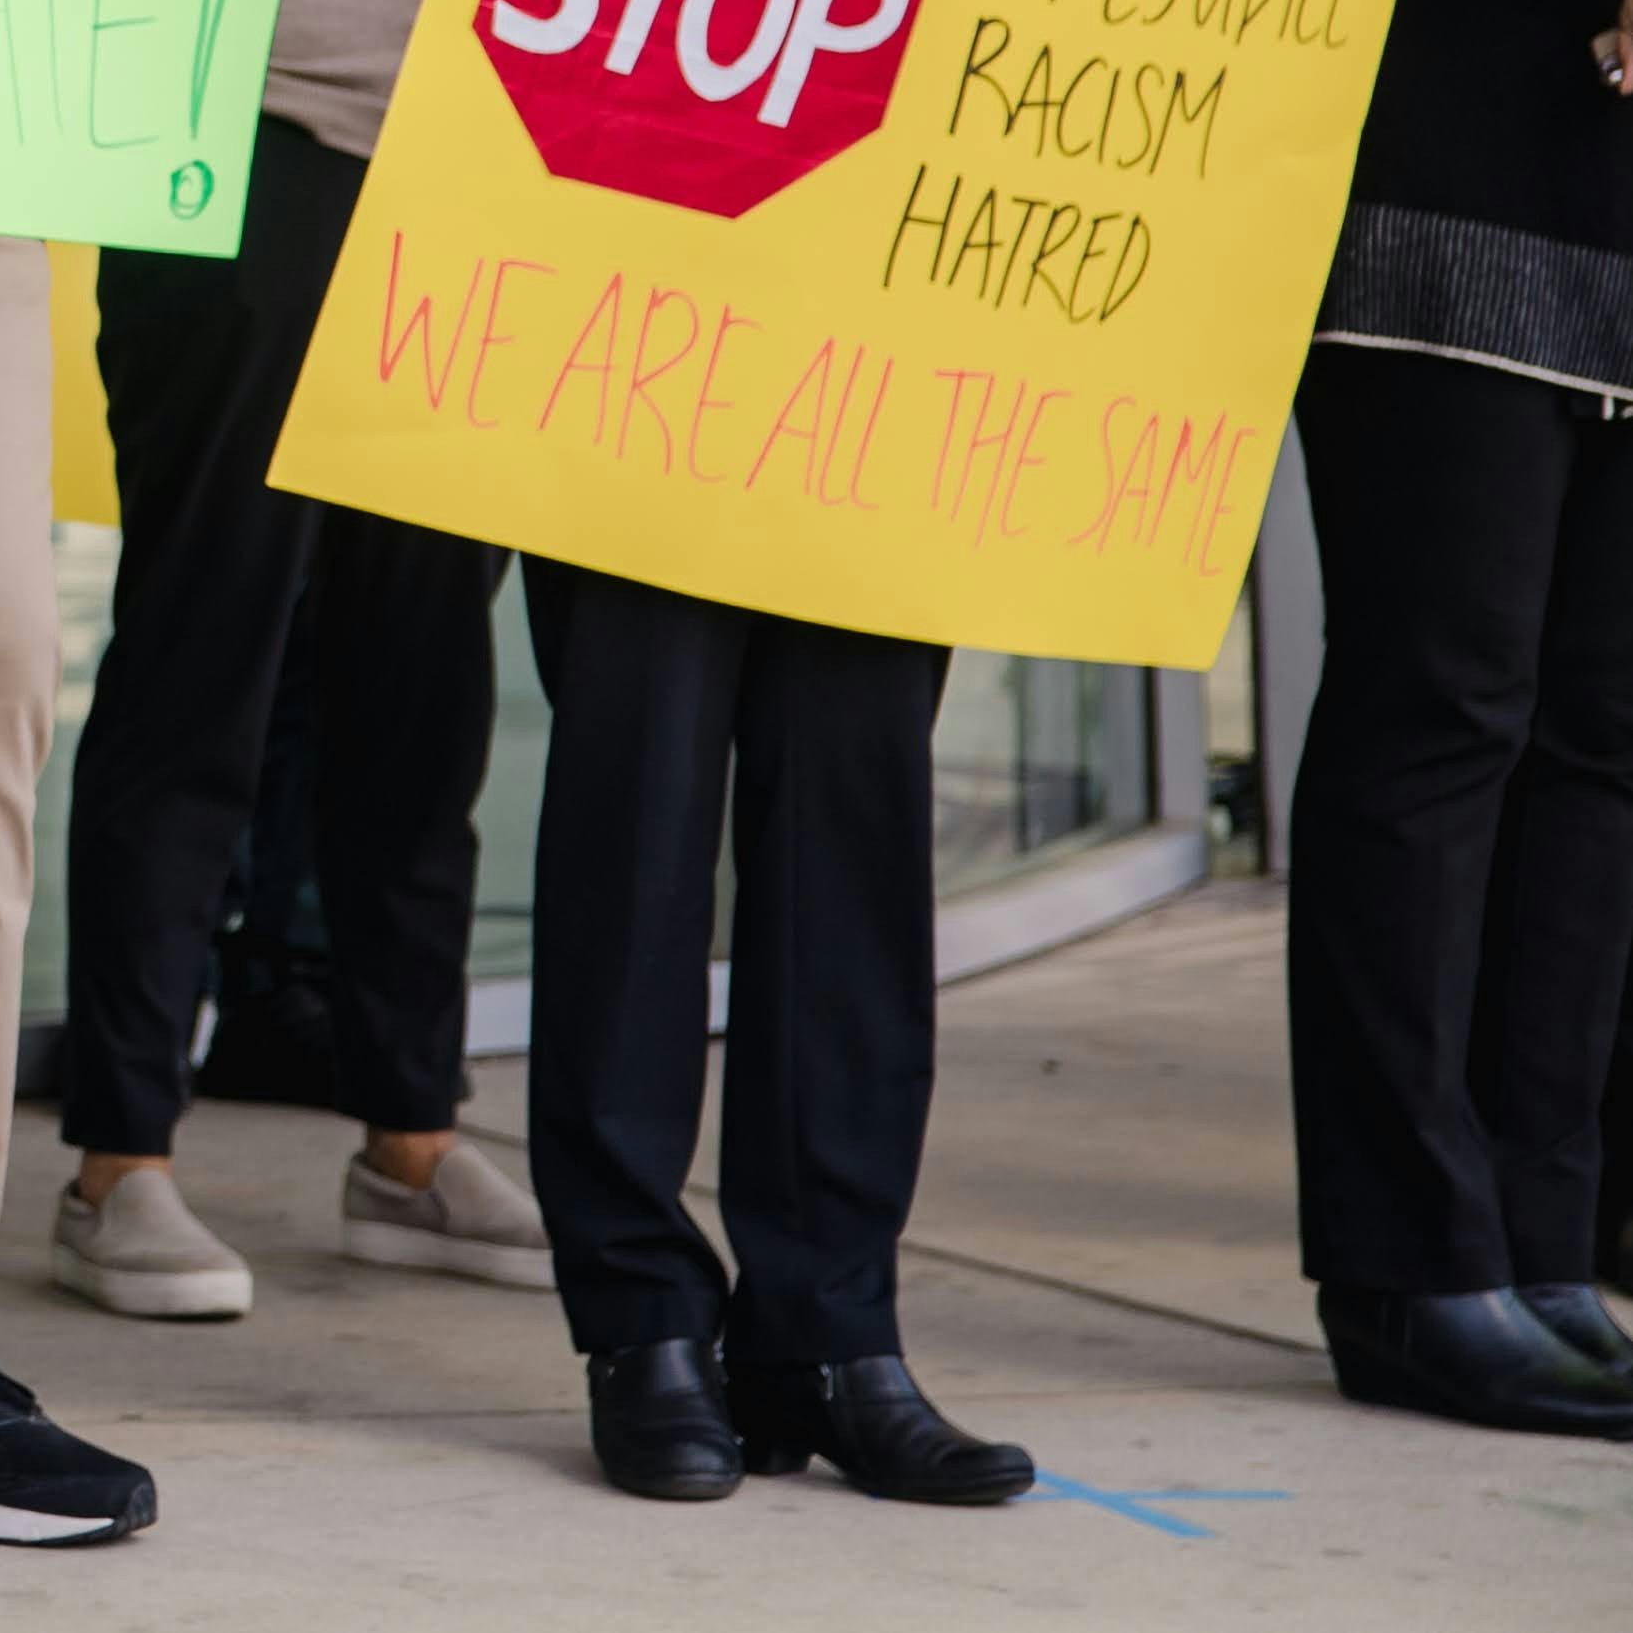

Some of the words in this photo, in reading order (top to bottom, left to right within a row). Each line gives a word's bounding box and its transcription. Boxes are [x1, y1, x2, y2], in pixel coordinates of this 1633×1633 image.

[950, 17, 1229, 179] RACISM
[882, 163, 1153, 325] HATRED
[378, 231, 557, 431] WE
[538, 272, 763, 485] ARE
[744, 337, 895, 513] ALL
[931, 367, 1074, 549] THE
[1067, 394, 1259, 580] SAME
